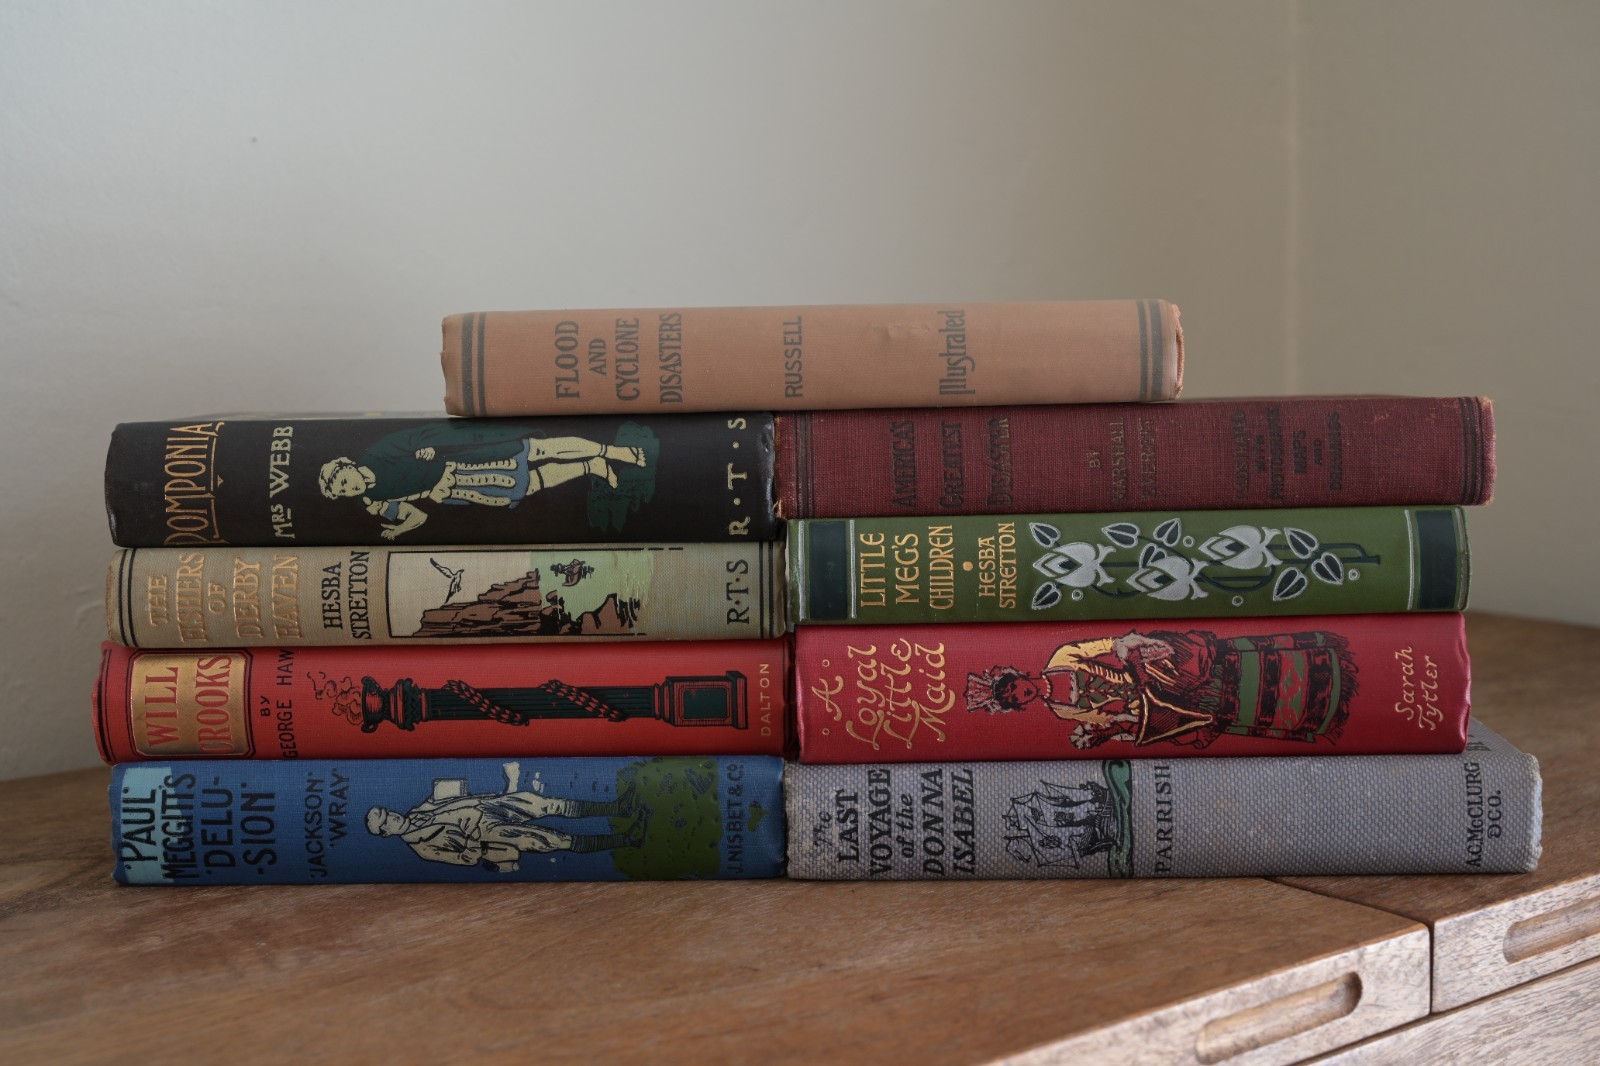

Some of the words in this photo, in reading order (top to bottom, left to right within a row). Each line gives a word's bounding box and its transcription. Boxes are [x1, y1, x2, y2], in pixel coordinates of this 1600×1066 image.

[555, 320, 581, 400] FLOOD
[589, 338, 607, 375] AND
[615, 317, 640, 401] CYCLONE
[658, 312, 683, 404] DISASTERS
[783, 316, 802, 399] RUSSELL
[937, 309, 976, 396] Illustrated
[163, 421, 229, 545] POMPONIA
[269, 425, 294, 499] WEBB
[938, 421, 964, 509] GREATEST
[986, 416, 1012, 507] DISASTER
[147, 574, 168, 626] THE
[176, 552, 208, 643] FISHERS
[208, 581, 227, 615] OF
[232, 556, 264, 639] DERBY
[272, 554, 303, 640] HAVEN
[321, 562, 343, 630] HESBA
[349, 551, 372, 640] STRETTON
[860, 532, 886, 607] LITTLE
[891, 533, 920, 604] MEG'S
[928, 524, 954, 610] CHILDREN
[978, 536, 996, 597] HESBA
[998, 522, 1017, 609] STRETTON
[145, 666, 180, 746] WILL
[195, 655, 233, 754] CROOKS
[260, 696, 271, 717] BY
[277, 650, 297, 687] HAW
[761, 663, 771, 737] DALTON
[811, 675, 844, 721] A
[846, 644, 887, 750] Loyal
[880, 638, 920, 749] Little
[914, 642, 956, 742] Maid
[1394, 646, 1416, 721] Sarah
[1416, 655, 1444, 731] Tytler
[277, 699, 298, 759] GEORGE
[812, 811, 834, 847] The
[834, 788, 860, 863] LAST
[868, 768, 892, 876] VOYAGE
[896, 793, 914, 831] the
[896, 834, 914, 858] of
[921, 769, 945, 875] DONNA
[952, 768, 976, 875] ISABEL
[1154, 764, 1173, 873] PARRISH
